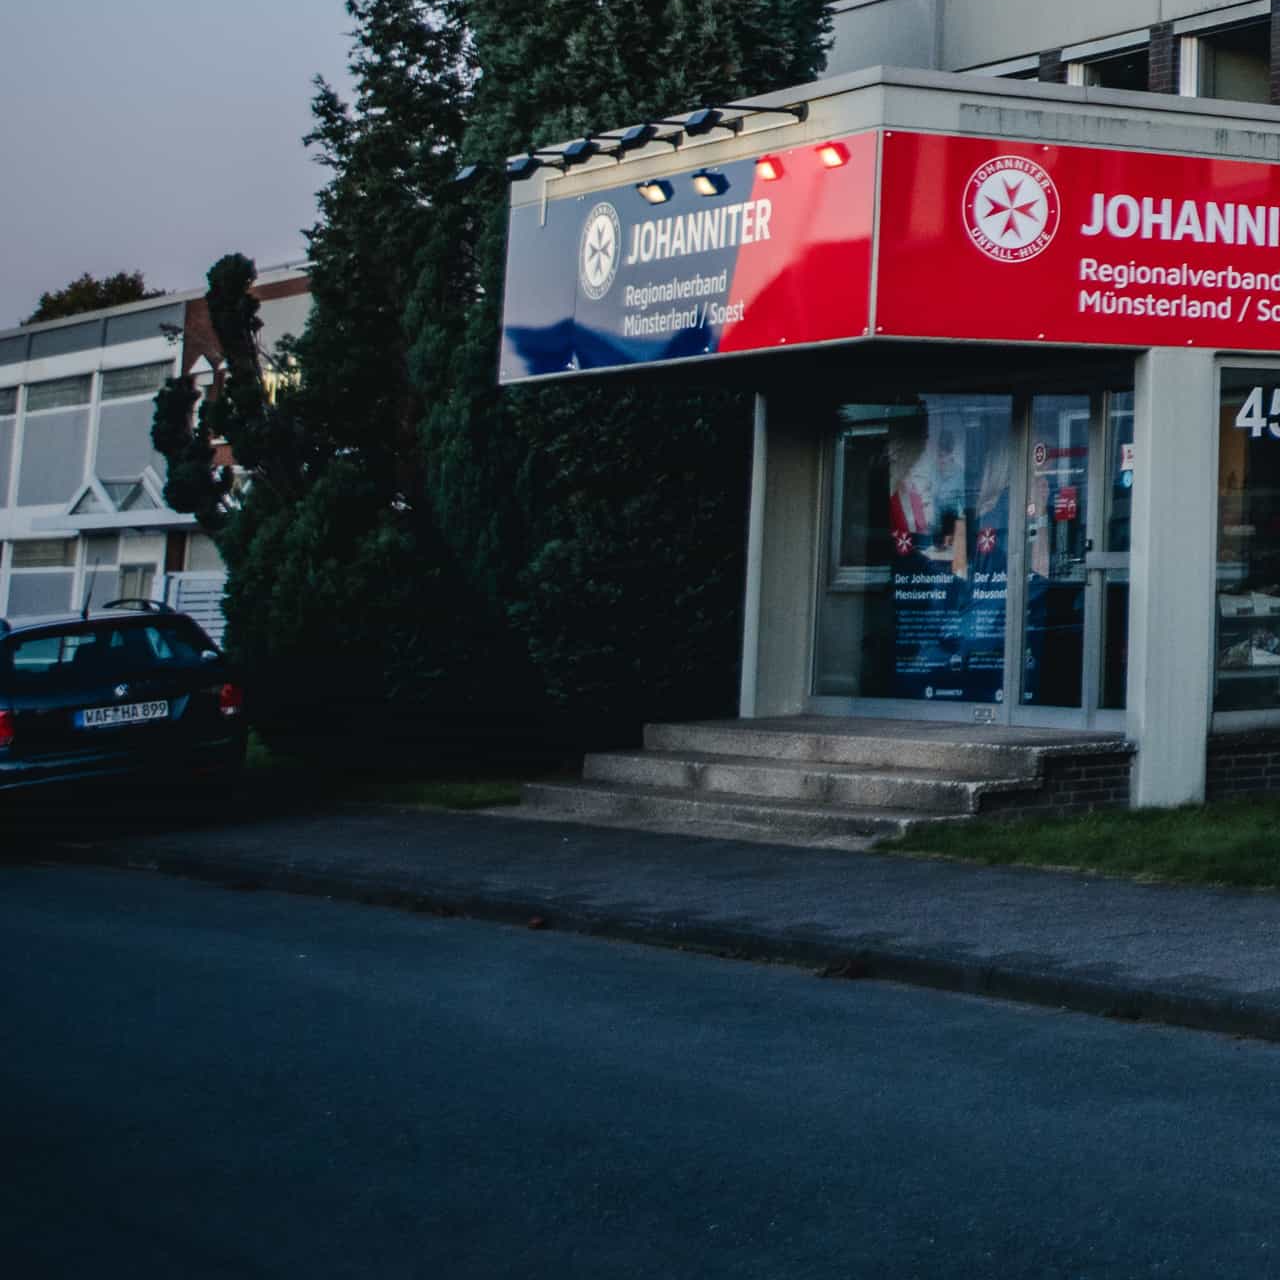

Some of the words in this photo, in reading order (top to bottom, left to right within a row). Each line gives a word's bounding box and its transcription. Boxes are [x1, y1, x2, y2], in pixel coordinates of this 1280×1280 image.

[627, 198, 772, 265] JOHANNITER
[625, 269, 727, 311] Regionalverband
[1078, 290, 1232, 319] Münsterland
[624, 304, 698, 337] Münsterland
[708, 299, 745, 326] Soest
